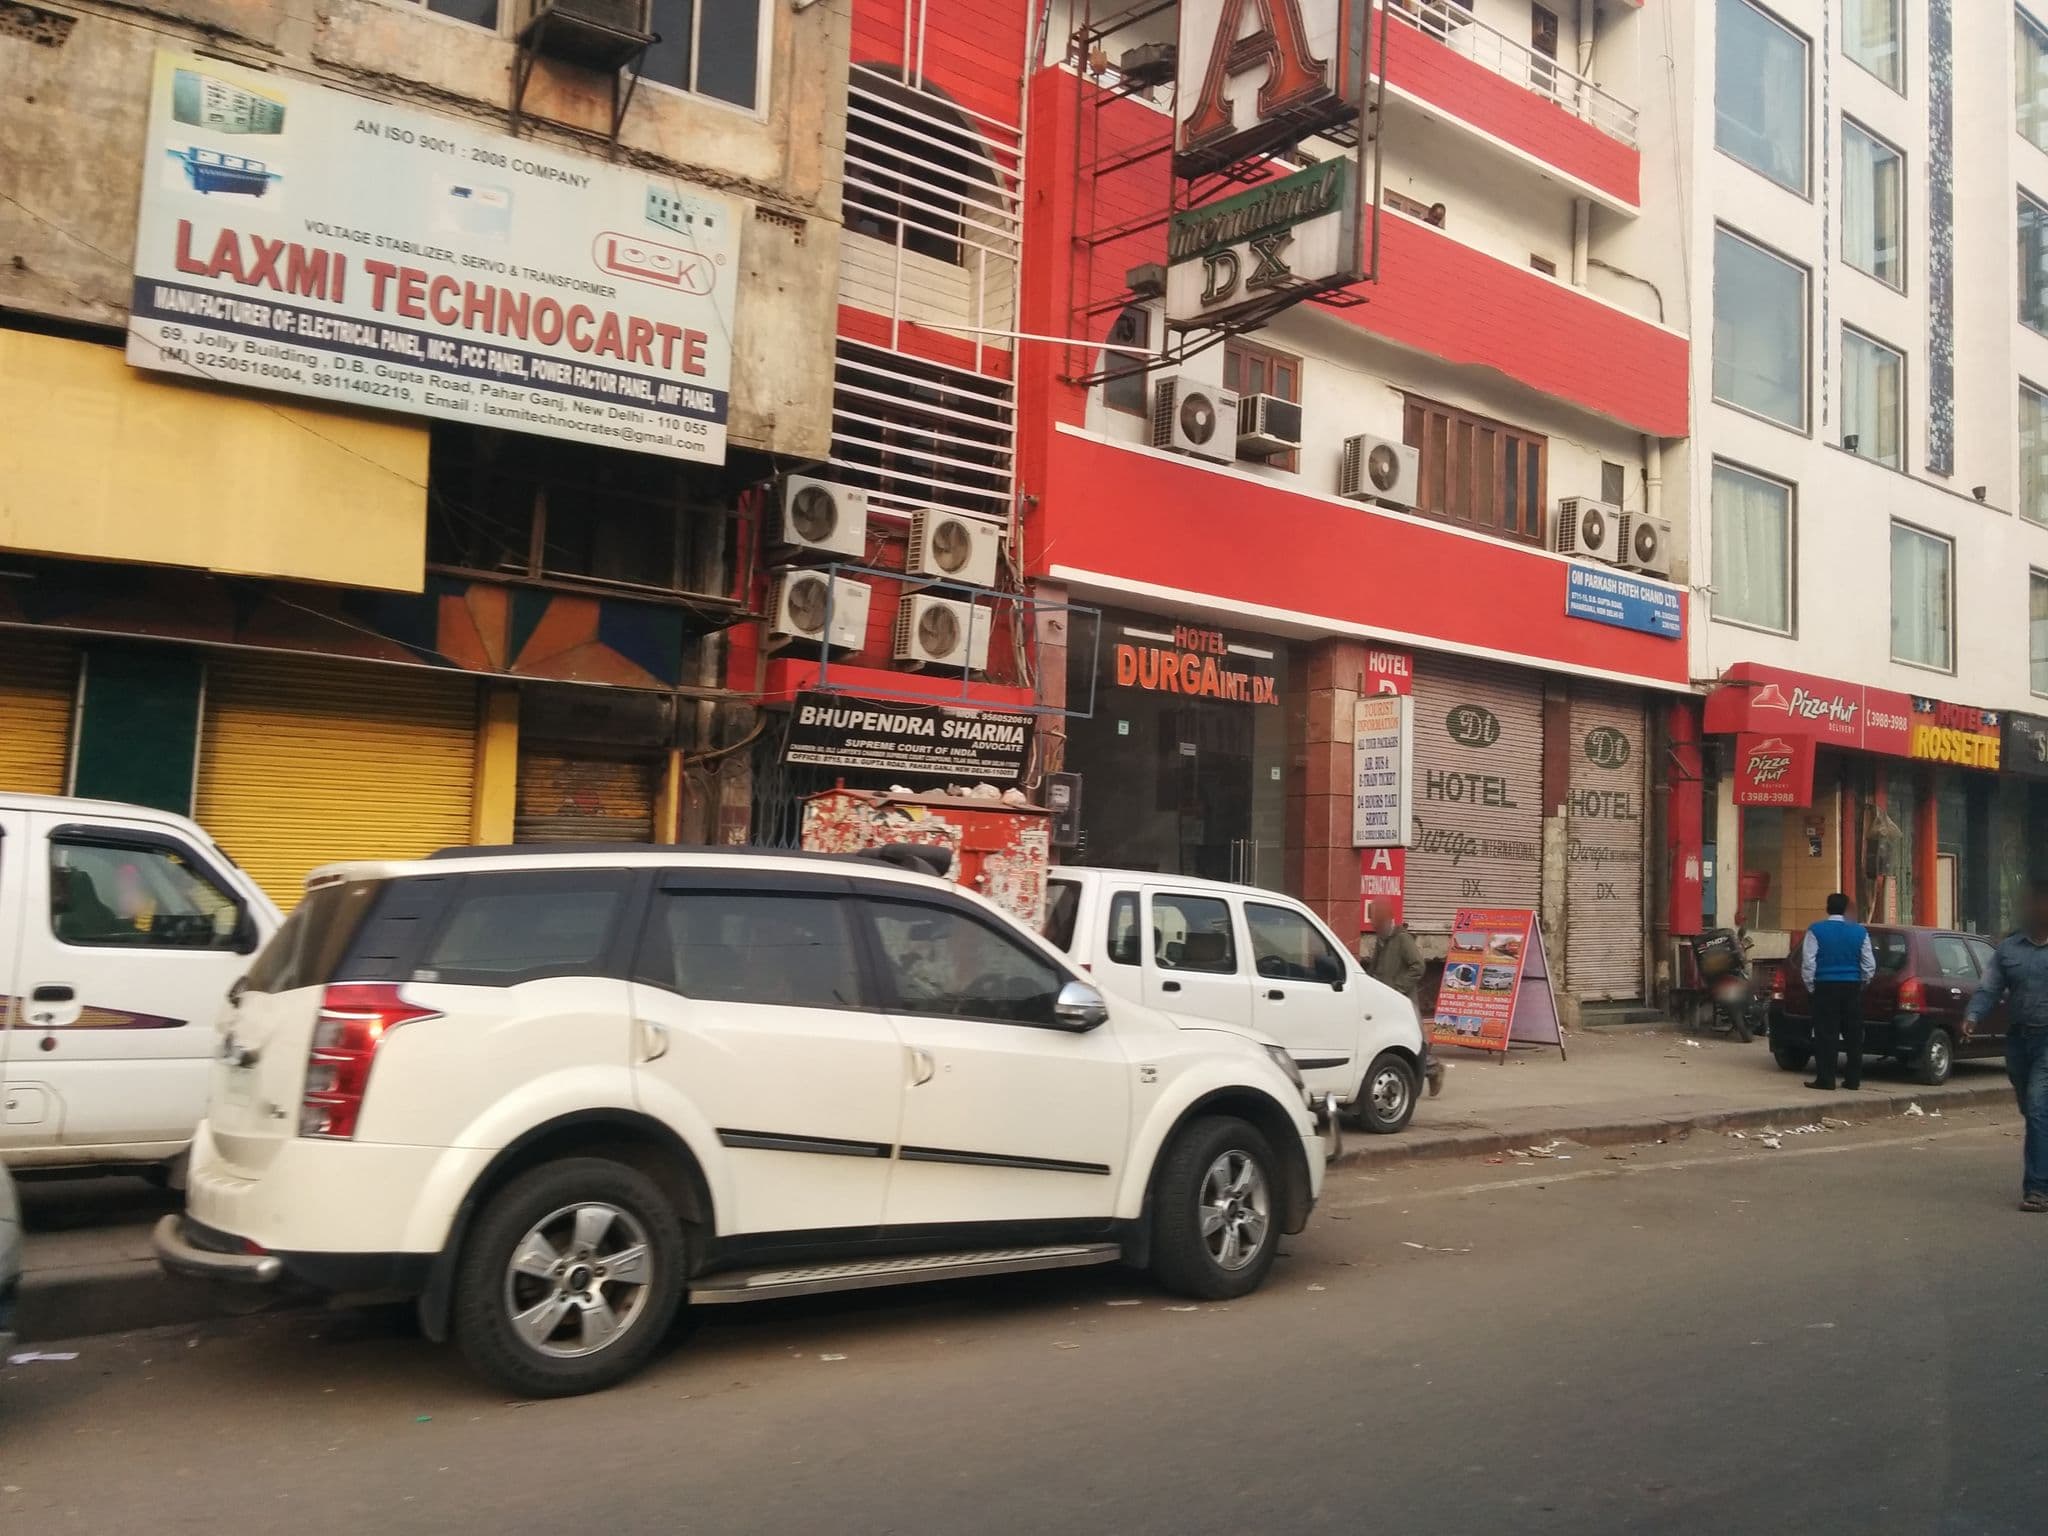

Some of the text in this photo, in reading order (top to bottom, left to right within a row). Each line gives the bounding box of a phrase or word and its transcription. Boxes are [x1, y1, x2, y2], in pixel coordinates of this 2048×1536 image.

[354, 119, 380, 136] AN
[384, 127, 415, 144] ISO
[419, 135, 455, 155] 9001
[472, 148, 508, 168] 2008
[511, 158, 591, 189] COMPANY
[304, 218, 617, 299] VOLTAGE STABILIZER, SERVO & TRANSFORMER
[1201, 231, 1296, 307] DX
[176, 218, 708, 377] LAXMI TECHNOCARTE
[154, 285, 716, 413] MANUFACTURER OF: ELECTRICAL PANEL, MCC, PCC PANEL, POWER FACTOR PANEL, AMF PANEL
[160, 325, 187, 344] 69,
[193, 331, 238, 353] Jolly
[244, 337, 318, 369] Building
[333, 356, 369, 374] D.B.
[374, 364, 425, 386] Gupta
[429, 374, 475, 396] Road,
[479, 382, 526, 403] Pahar
[529, 392, 569, 415] Ganj,
[572, 401, 603, 418] New
[606, 405, 644, 425] Delhi
[657, 414, 681, 431] 110
[683, 419, 708, 437] 055
[159, 344, 190, 364] (M)
[196, 350, 306, 386] 9250518004,
[311, 373, 415, 403] 9811402219,
[424, 391, 469, 411] Email
[483, 401, 706, 453] laxmitechnocrates@gmail.com
[1571, 570, 1679, 608] OM PARKASH FATEH CHAND LTD.
[1175, 625, 1227, 655] HOTEL
[1115, 643, 1279, 705] DURGA INT. DX.
[1369, 651, 1408, 676] HOTEL
[1364, 702, 1394, 717] TOURIST
[1788, 687, 1858, 723] Pizza Hut
[799, 705, 1026, 744] BHUPENDRA SHARMA
[1357, 717, 1398, 732] INFORMATION
[1828, 722, 1855, 735] DELIVERY
[1871, 711, 1909, 731] 3988-3988
[844, 738, 977, 758] SUPREME COURT OF INDIA
[971, 740, 1023, 753] ADVOCATE
[1914, 724, 2000, 769] ROSSETTE
[791, 753, 821, 762] OFFICE:
[861, 759, 884, 767] GUPTA
[909, 762, 933, 771] PAHAR
[955, 765, 970, 773] NEW
[1747, 755, 1791, 774] Pizza
[1753, 767, 1789, 785] Hut
[1365, 794, 1383, 808] HOURS
[1384, 793, 1397, 807] TAXI
[1426, 769, 1517, 808] HOTEL
[1747, 793, 1794, 802] 3988-3988
[1570, 789, 1638, 820] HOTEL
[1365, 811, 1388, 826] SERVICE
[1371, 848, 1392, 870] A
[1457, 912, 1472, 929] 24
